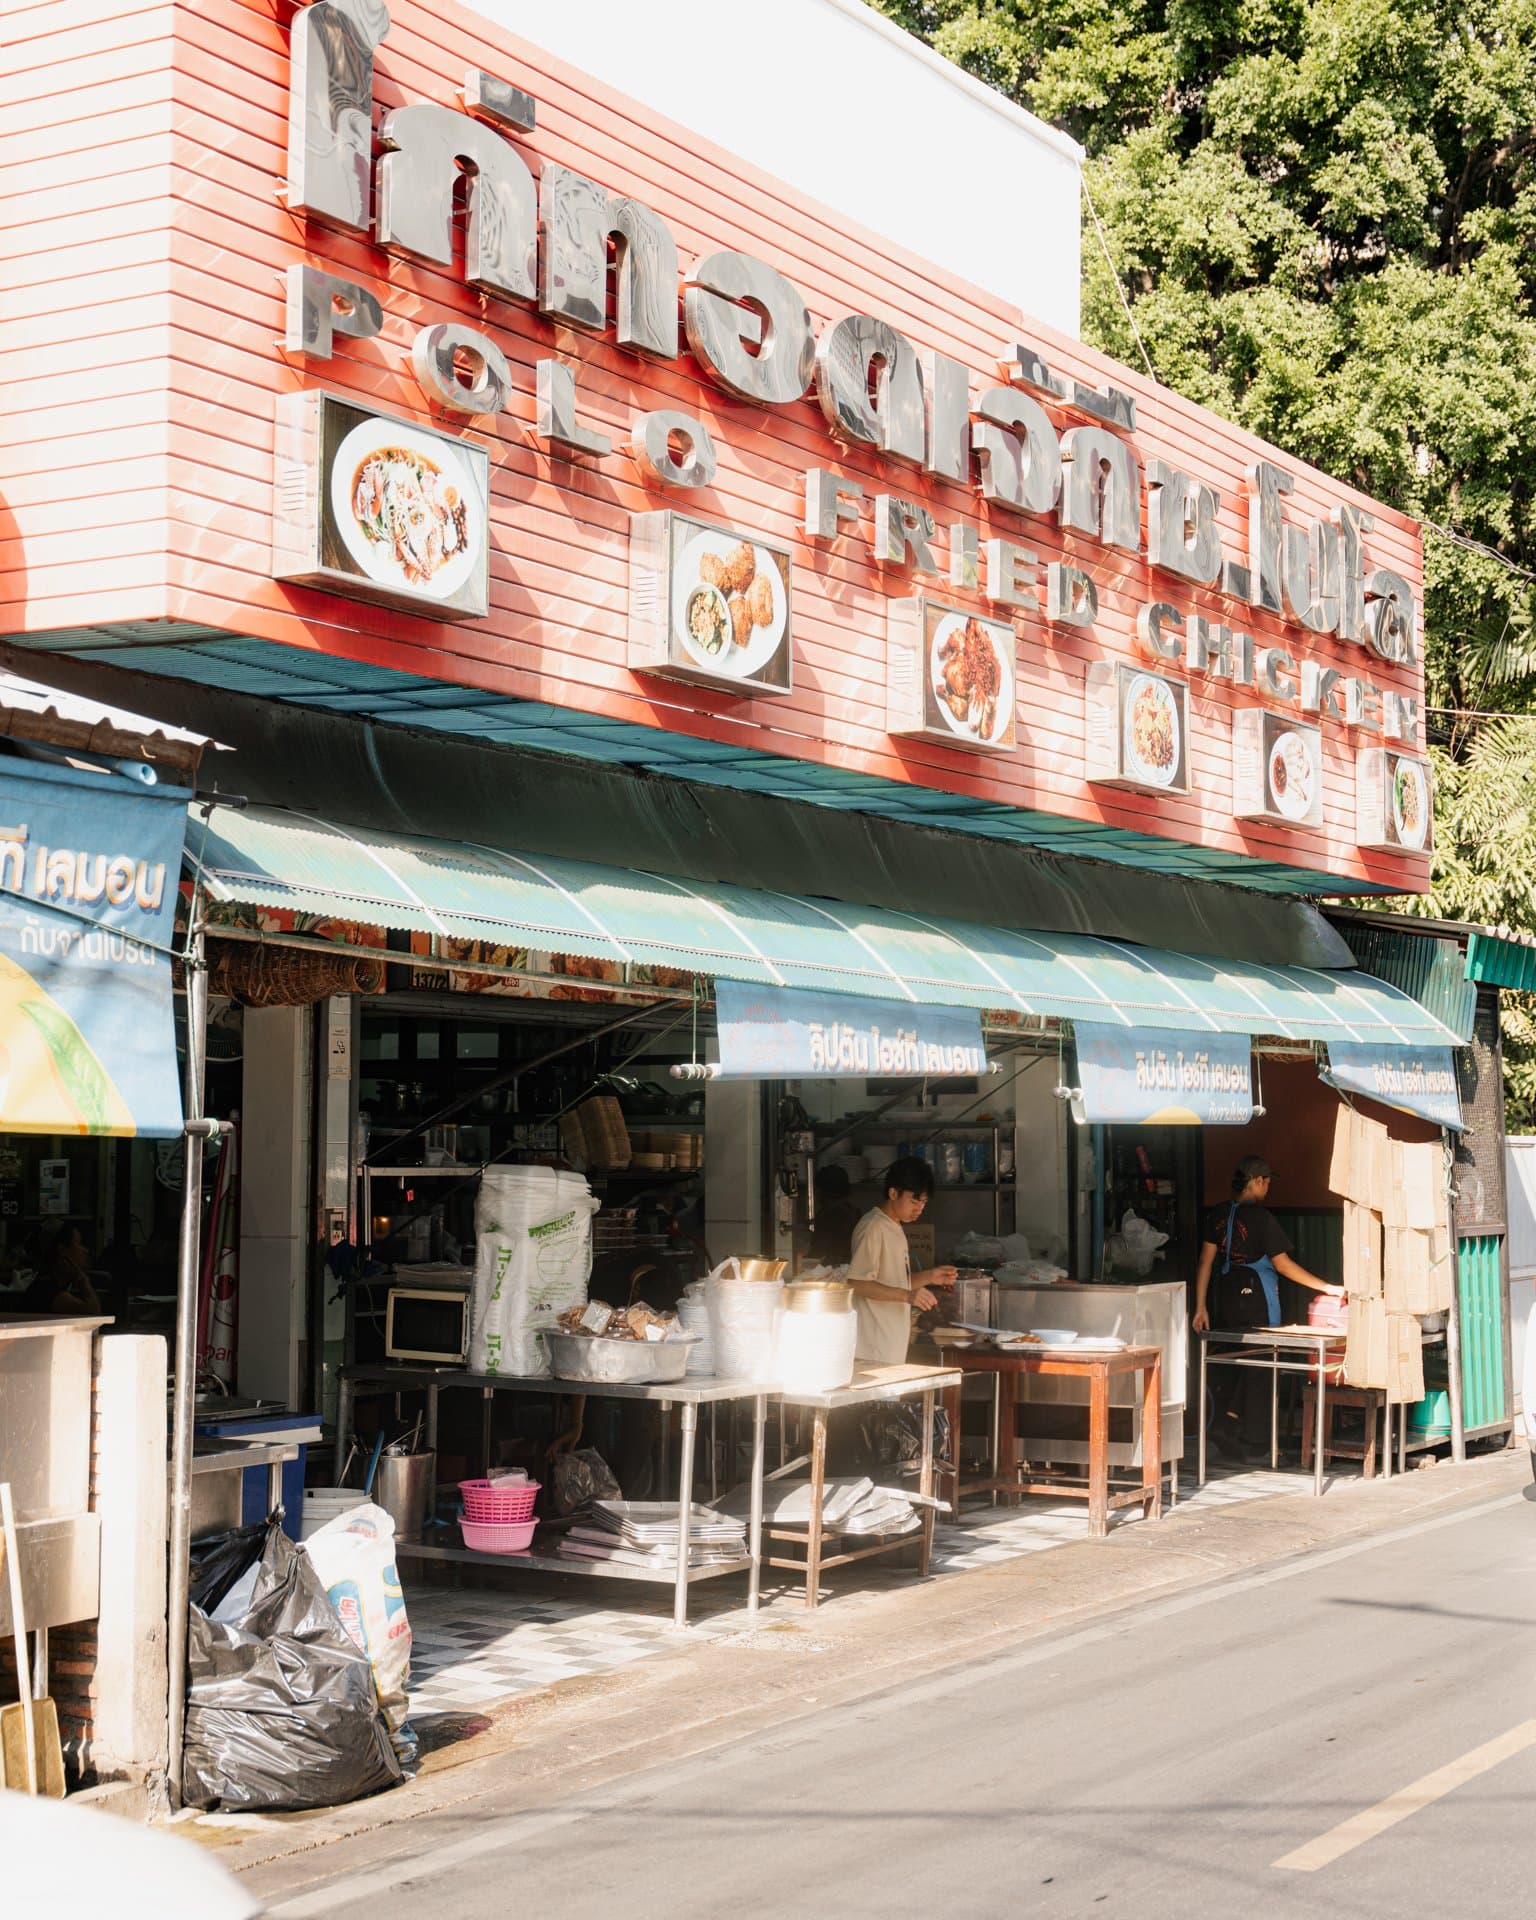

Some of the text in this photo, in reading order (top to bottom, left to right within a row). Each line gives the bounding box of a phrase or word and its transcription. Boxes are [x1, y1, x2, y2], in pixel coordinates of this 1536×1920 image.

[286, 264, 1417, 743] POLO FRIED CHICKEN
[34, 846, 166, 912] เลมอน
[921, 1040, 979, 1078] เลมอน
